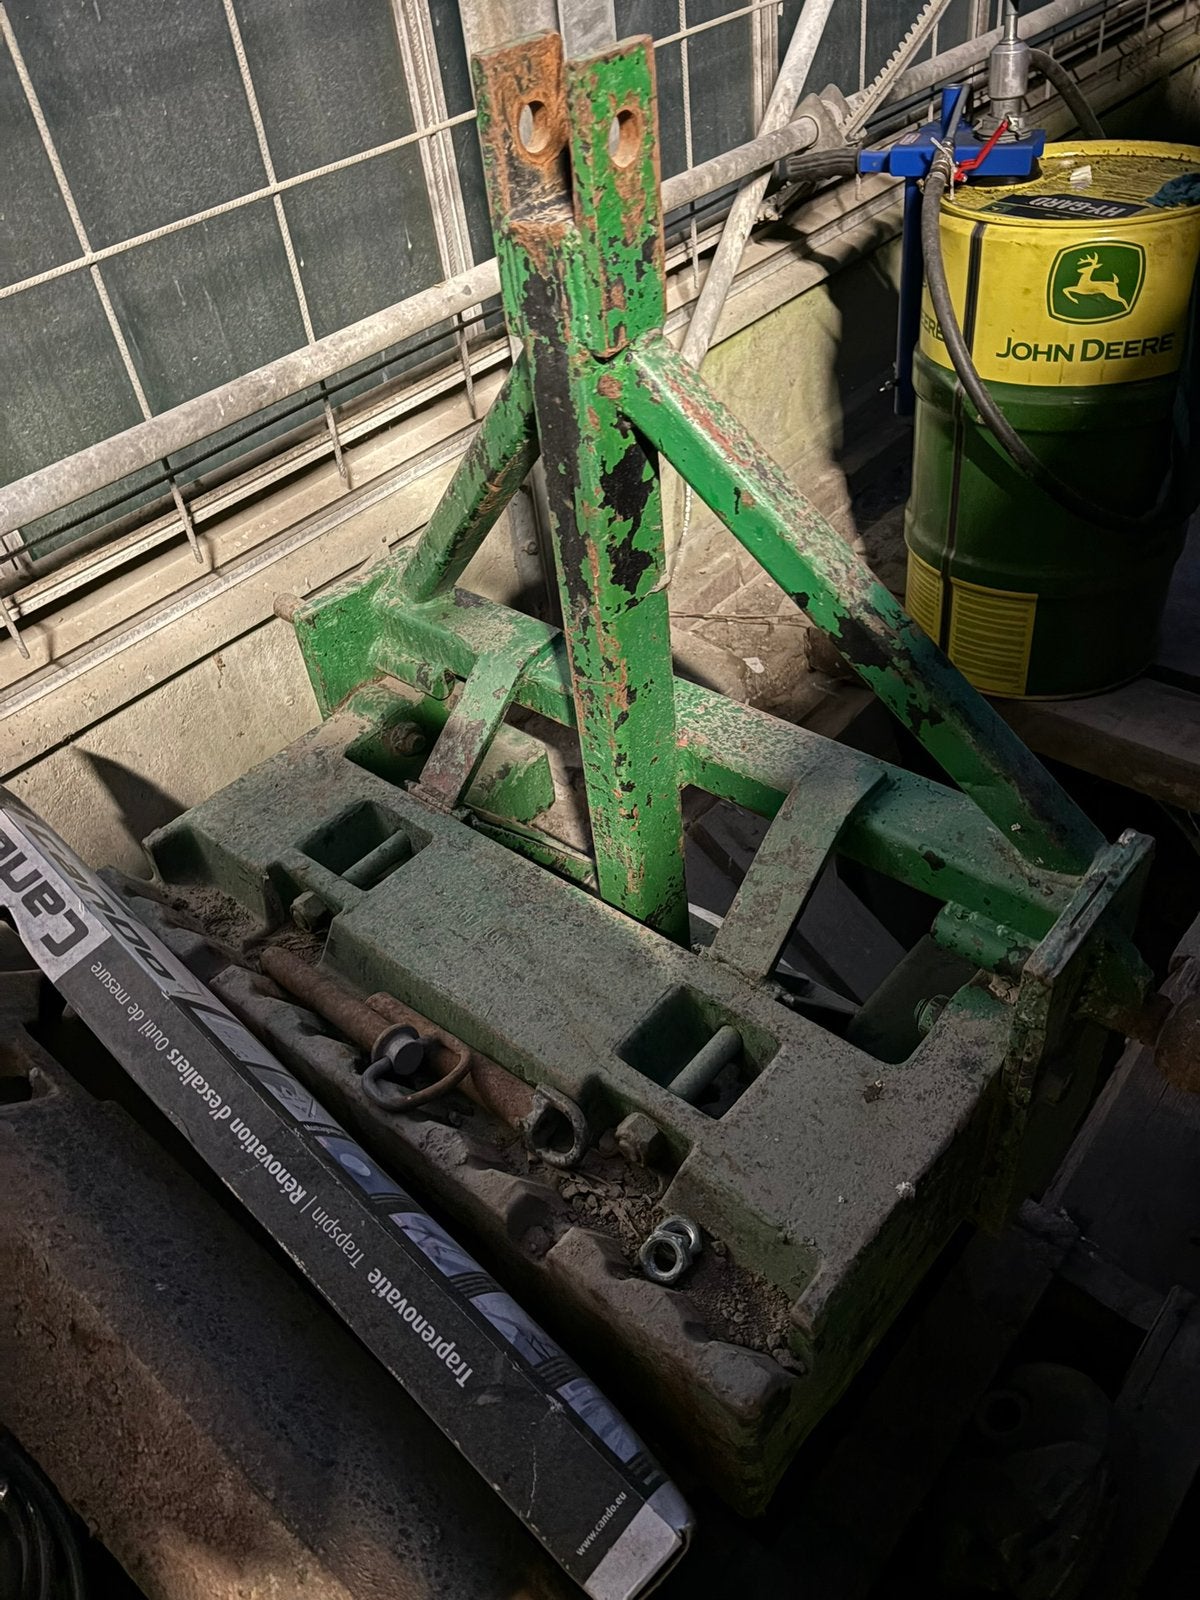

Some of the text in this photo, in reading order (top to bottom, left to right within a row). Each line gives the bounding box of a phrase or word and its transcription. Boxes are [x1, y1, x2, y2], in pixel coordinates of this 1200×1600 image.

[996, 332, 1175, 362] JOHN DEERE
[91, 962, 131, 1005] mesure
[127, 1003, 145, 1021] de
[138, 1019, 169, 1051] Outil
[229, 1118, 307, 1204] Rénovation
[311, 1206, 365, 1269] Trapspin
[367, 1267, 473, 1388] Traprenovatie
[576, 1491, 627, 1557] www.cando.eu
